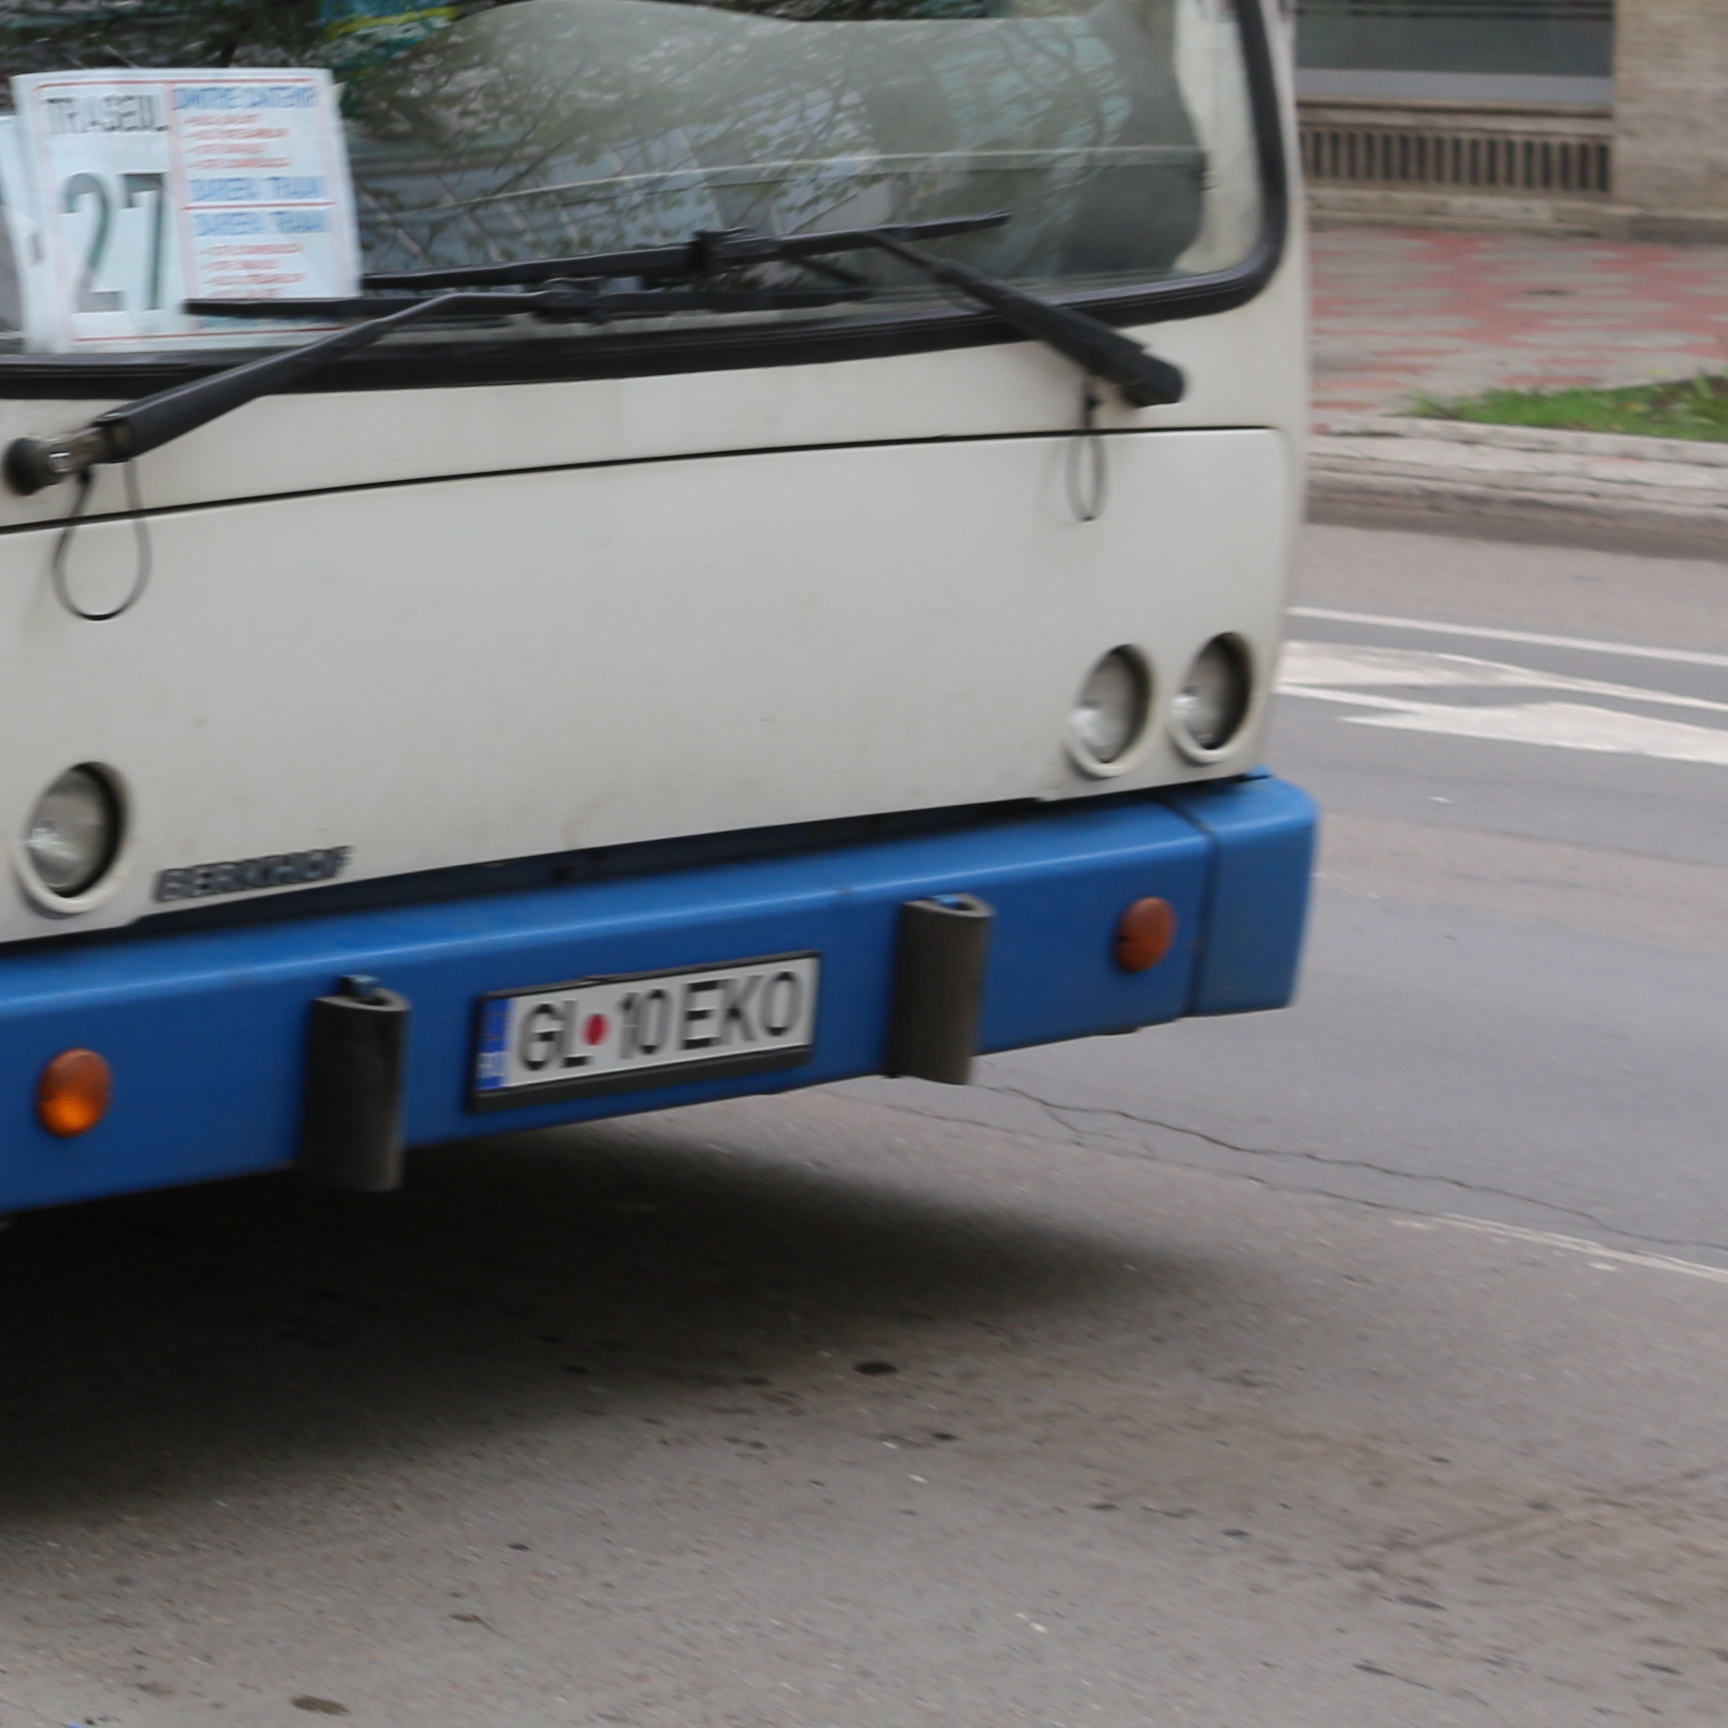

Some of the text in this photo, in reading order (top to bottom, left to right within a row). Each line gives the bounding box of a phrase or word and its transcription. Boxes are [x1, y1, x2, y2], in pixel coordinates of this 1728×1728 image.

[59, 172, 168, 313] 27
[518, 1000, 592, 1071] GL
[617, 988, 672, 1060] 10
[680, 970, 804, 1050] EKO
